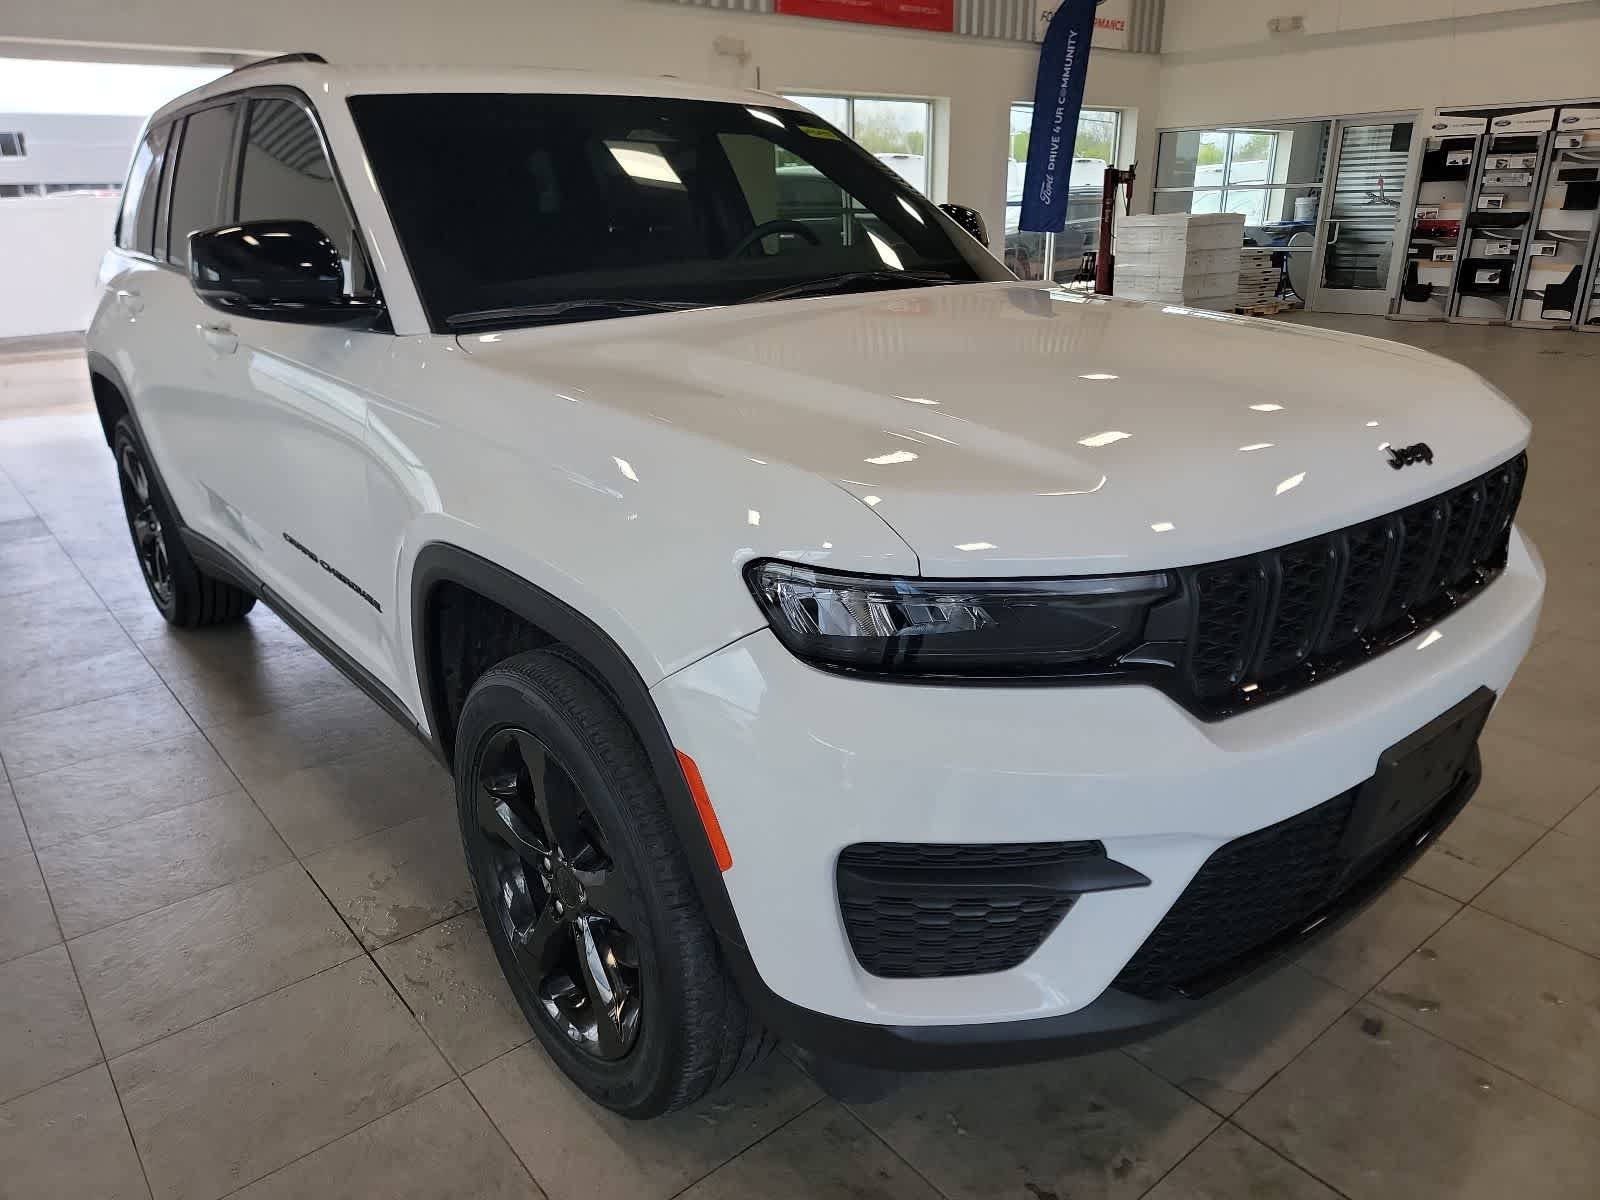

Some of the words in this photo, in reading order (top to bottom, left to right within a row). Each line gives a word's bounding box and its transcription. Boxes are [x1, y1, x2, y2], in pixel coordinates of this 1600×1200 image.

[1058, 30, 1078, 105] COMMUNITY
[1053, 125, 1062, 133] 4
[1055, 107, 1065, 124] UR
[1048, 135, 1060, 171] DRIVE
[1040, 174, 1054, 205] Ford
[1386, 442, 1433, 470] Jeep
